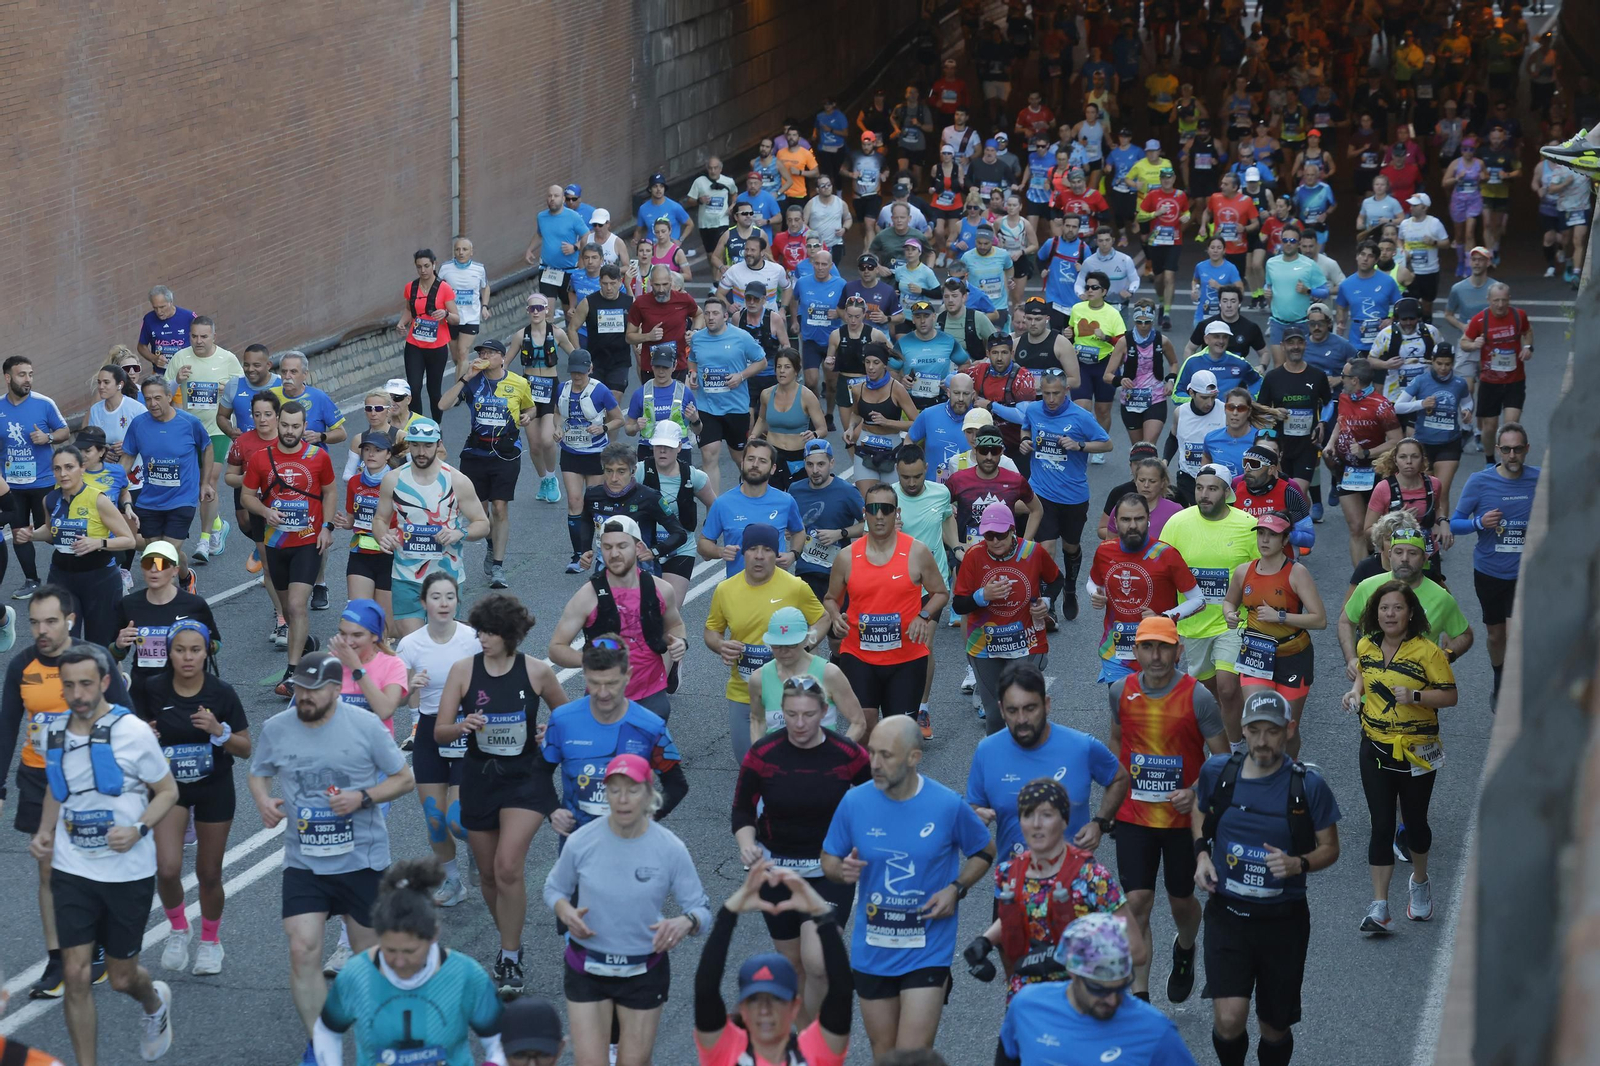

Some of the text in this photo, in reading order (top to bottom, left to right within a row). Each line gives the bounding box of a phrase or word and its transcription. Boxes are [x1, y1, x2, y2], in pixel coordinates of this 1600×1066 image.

[191, 395, 213, 403] TABOAS
[477, 411, 503, 420] ARMADA
[1040, 446, 1063, 454] JUANJE
[149, 471, 173, 479] CARLOS
[1242, 506, 1275, 517] GOLDEN
[359, 512, 375, 521] MARÍ
[409, 543, 436, 551] KIERAN
[808, 547, 830, 561] LÓPEZ
[996, 624, 1019, 633] ZURICH
[860, 632, 900, 642] JUAN DÍEZ
[986, 640, 1027, 653] CONSUELO
[1250, 640, 1273, 650] ZURICH
[138, 649, 158, 657] VALE
[1244, 656, 1265, 670] ROCÍO
[1251, 696, 1278, 712] Gibson
[491, 715, 521, 723] ZURICH
[487, 736, 517, 745] EMMA
[176, 745, 206, 754] ZURICH
[1147, 757, 1177, 765] ZURICH
[175, 769, 200, 778] JAJA
[1136, 779, 1177, 791] VICENTE
[75, 812, 107, 821] ZURICH
[300, 831, 352, 845] WOJCIECH
[1244, 863, 1266, 874] 13209
[1243, 874, 1264, 886] SEB
[885, 897, 918, 905] ZURICH
[866, 924, 925, 936] RICARDO MORAIS
[605, 953, 628, 964] EVA
[398, 1048, 438, 1064] ZURICH
